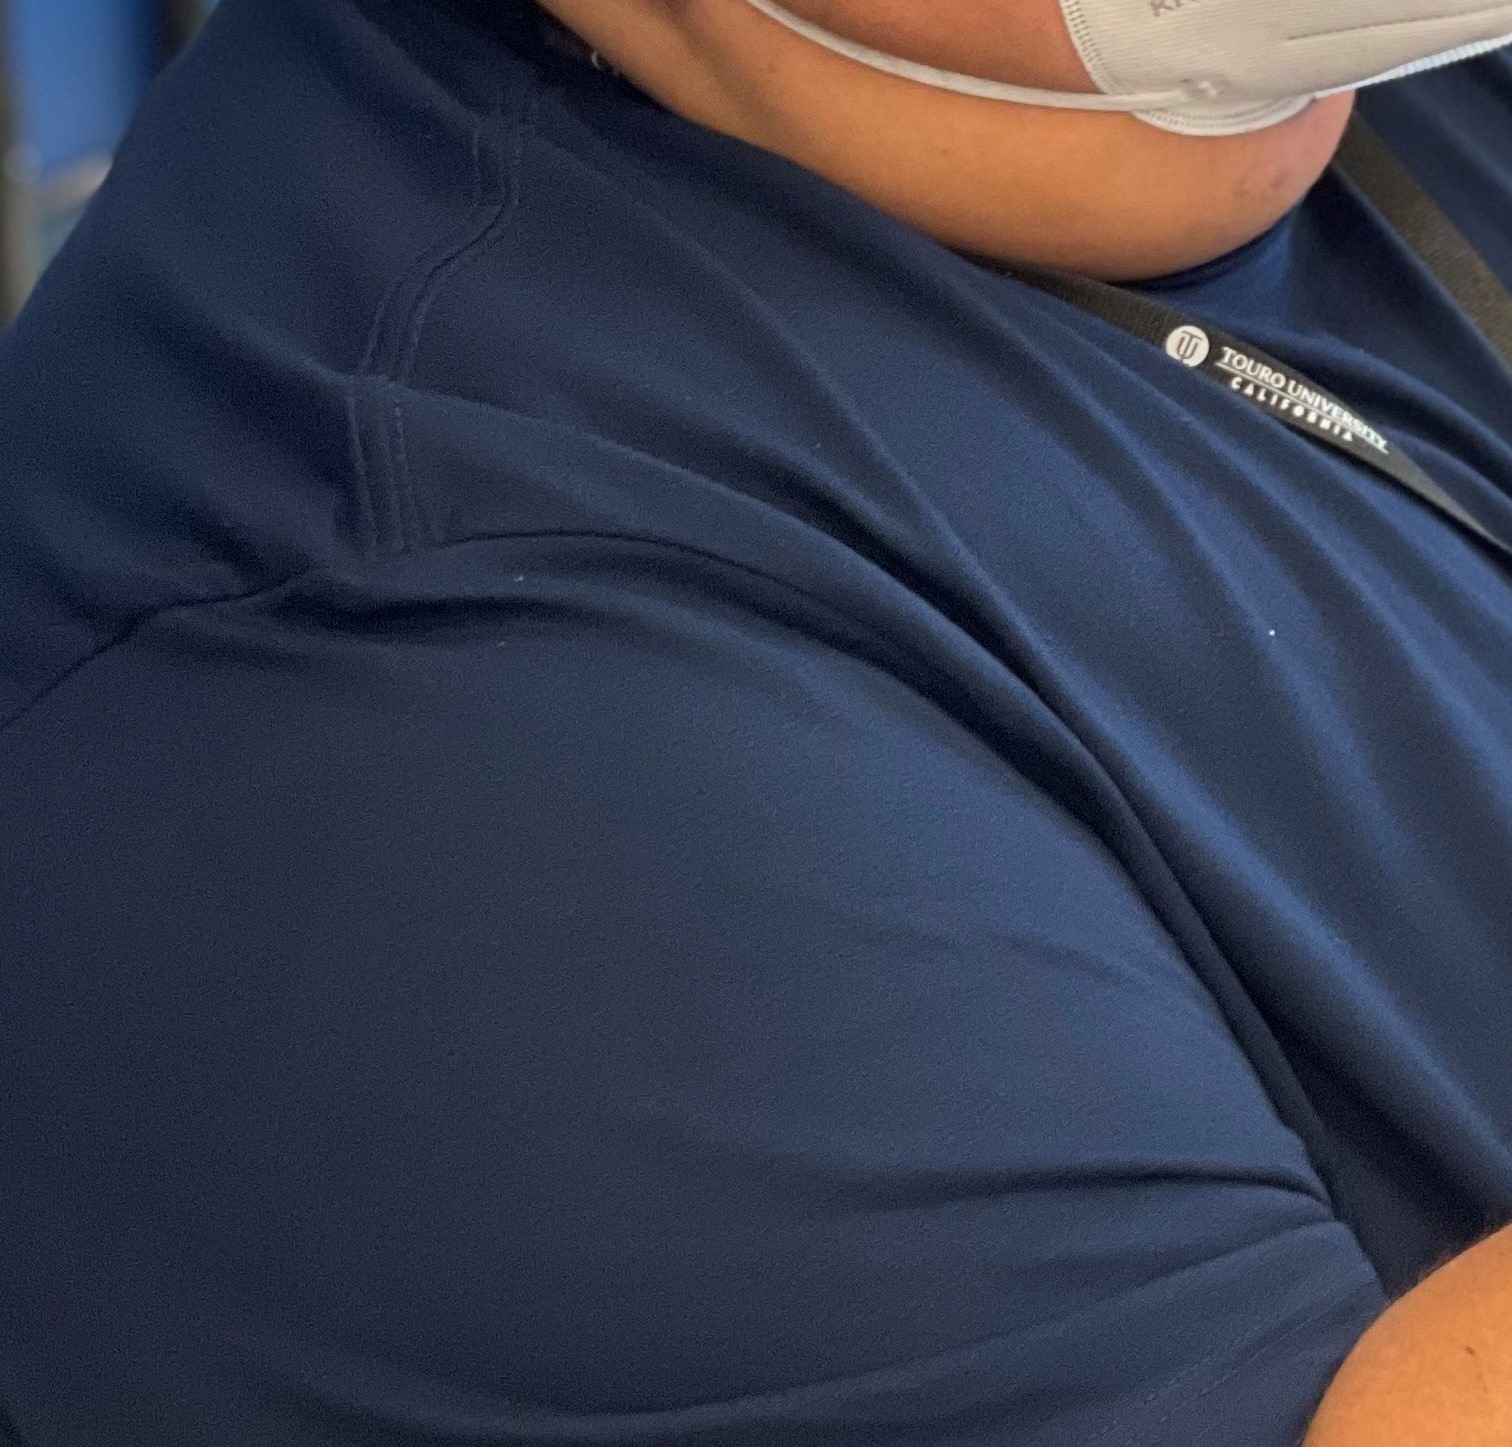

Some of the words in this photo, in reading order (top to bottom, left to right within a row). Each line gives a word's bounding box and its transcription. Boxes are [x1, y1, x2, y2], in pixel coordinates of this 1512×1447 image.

[1220, 345, 1287, 388] TOURO
[1286, 379, 1389, 450] UNIVERSITY
[1230, 375, 1353, 442] CALIFORNIA
